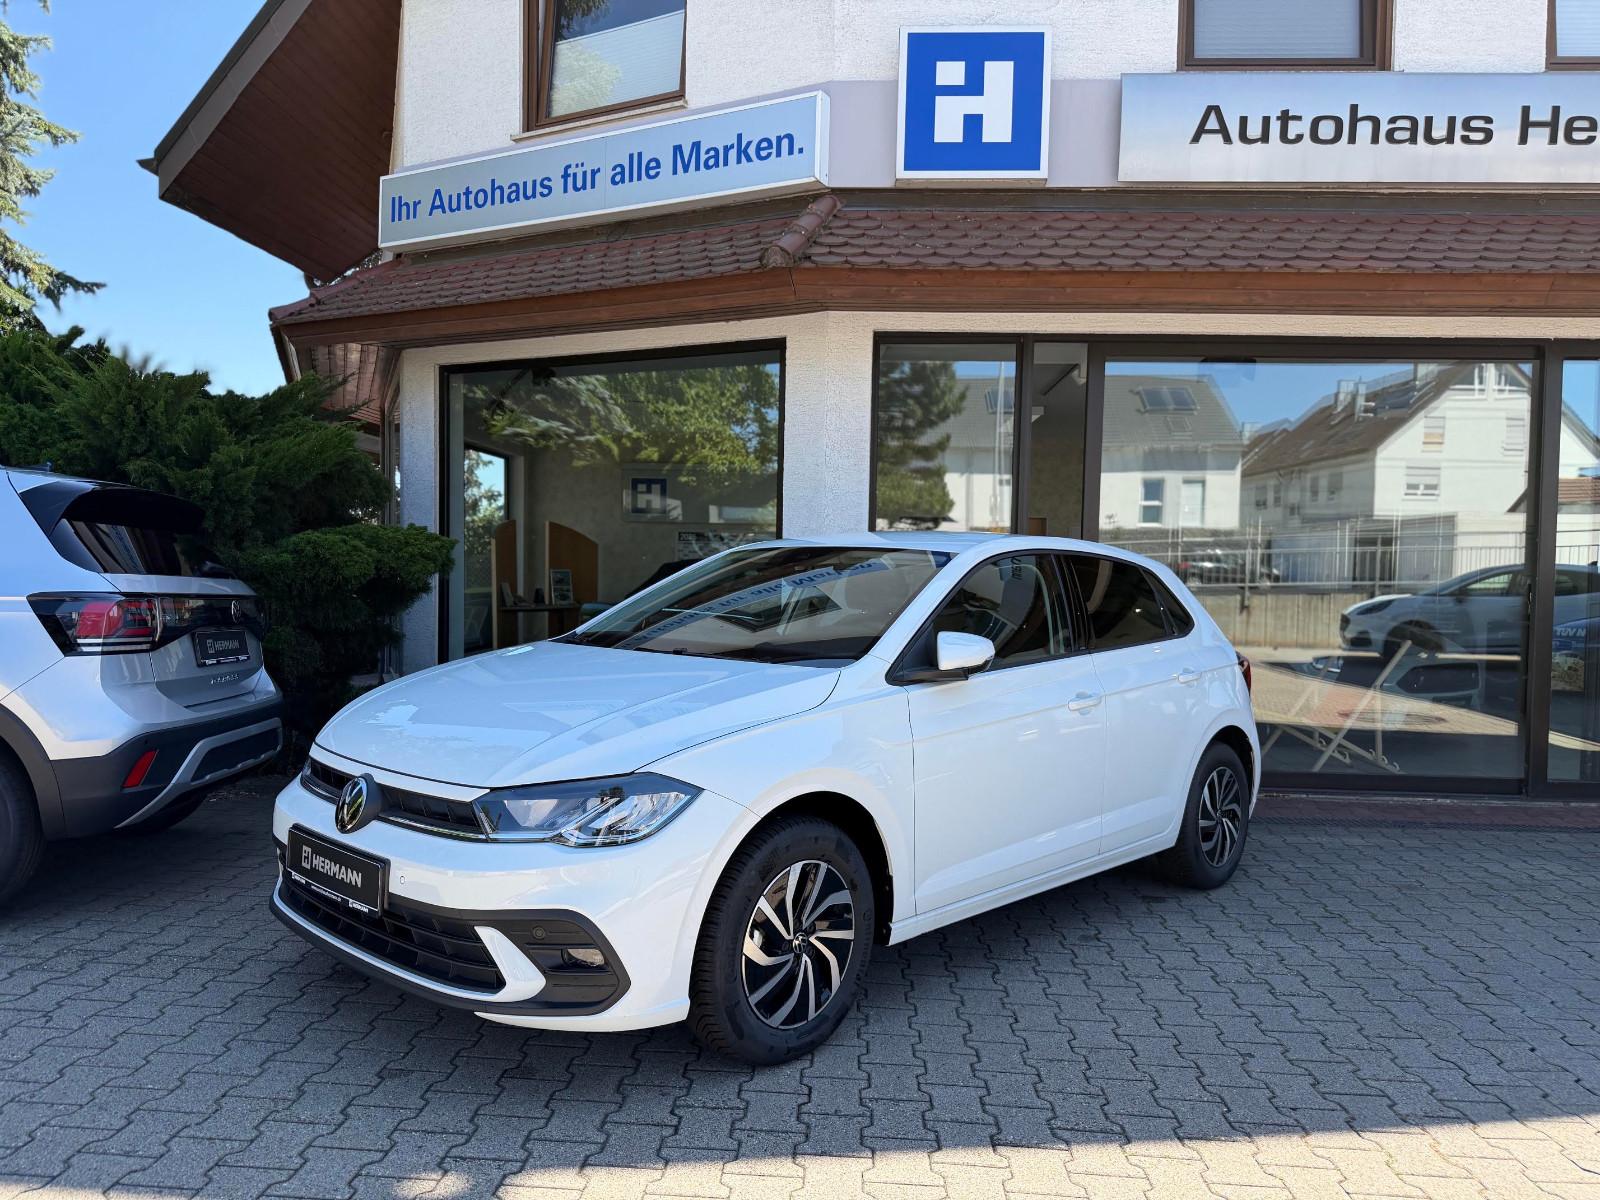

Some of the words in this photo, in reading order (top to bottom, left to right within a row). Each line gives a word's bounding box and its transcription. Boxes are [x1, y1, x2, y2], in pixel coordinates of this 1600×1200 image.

[1190, 104, 1493, 145] Autohaus
[1519, 106, 1597, 145] He
[392, 196, 421, 222] Ihr
[429, 177, 552, 216] Autohaus
[561, 163, 600, 193] für
[611, 152, 661, 185] alle
[673, 133, 803, 175] Marken.
[312, 853, 362, 888] HERMANN
